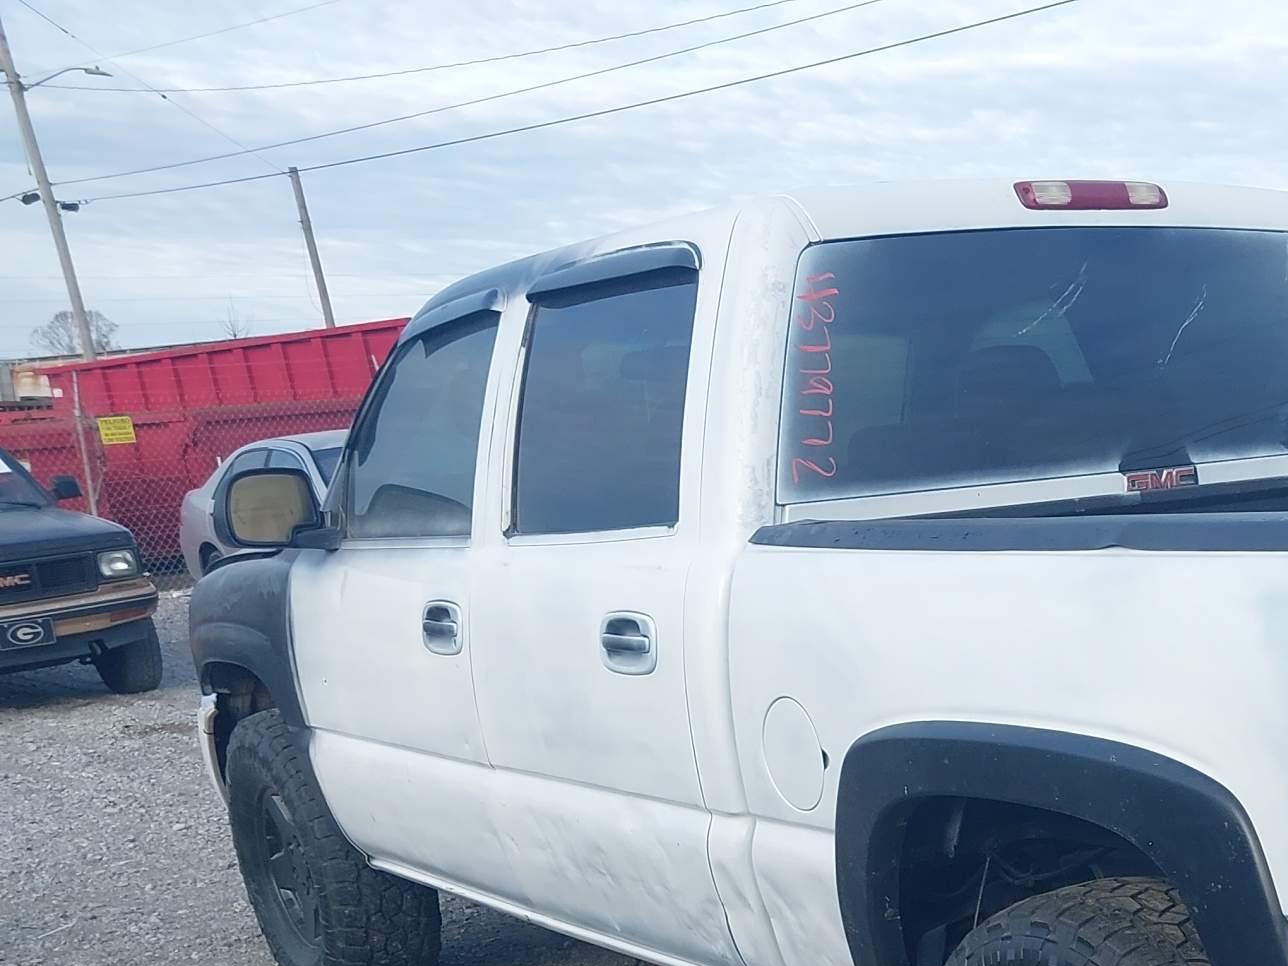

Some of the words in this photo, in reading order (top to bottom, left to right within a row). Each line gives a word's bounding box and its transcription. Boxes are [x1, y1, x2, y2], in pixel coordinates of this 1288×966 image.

[792, 272, 839, 485] 43779772
[1125, 465, 1196, 492] GMC
[0, 573, 31, 588] MC
